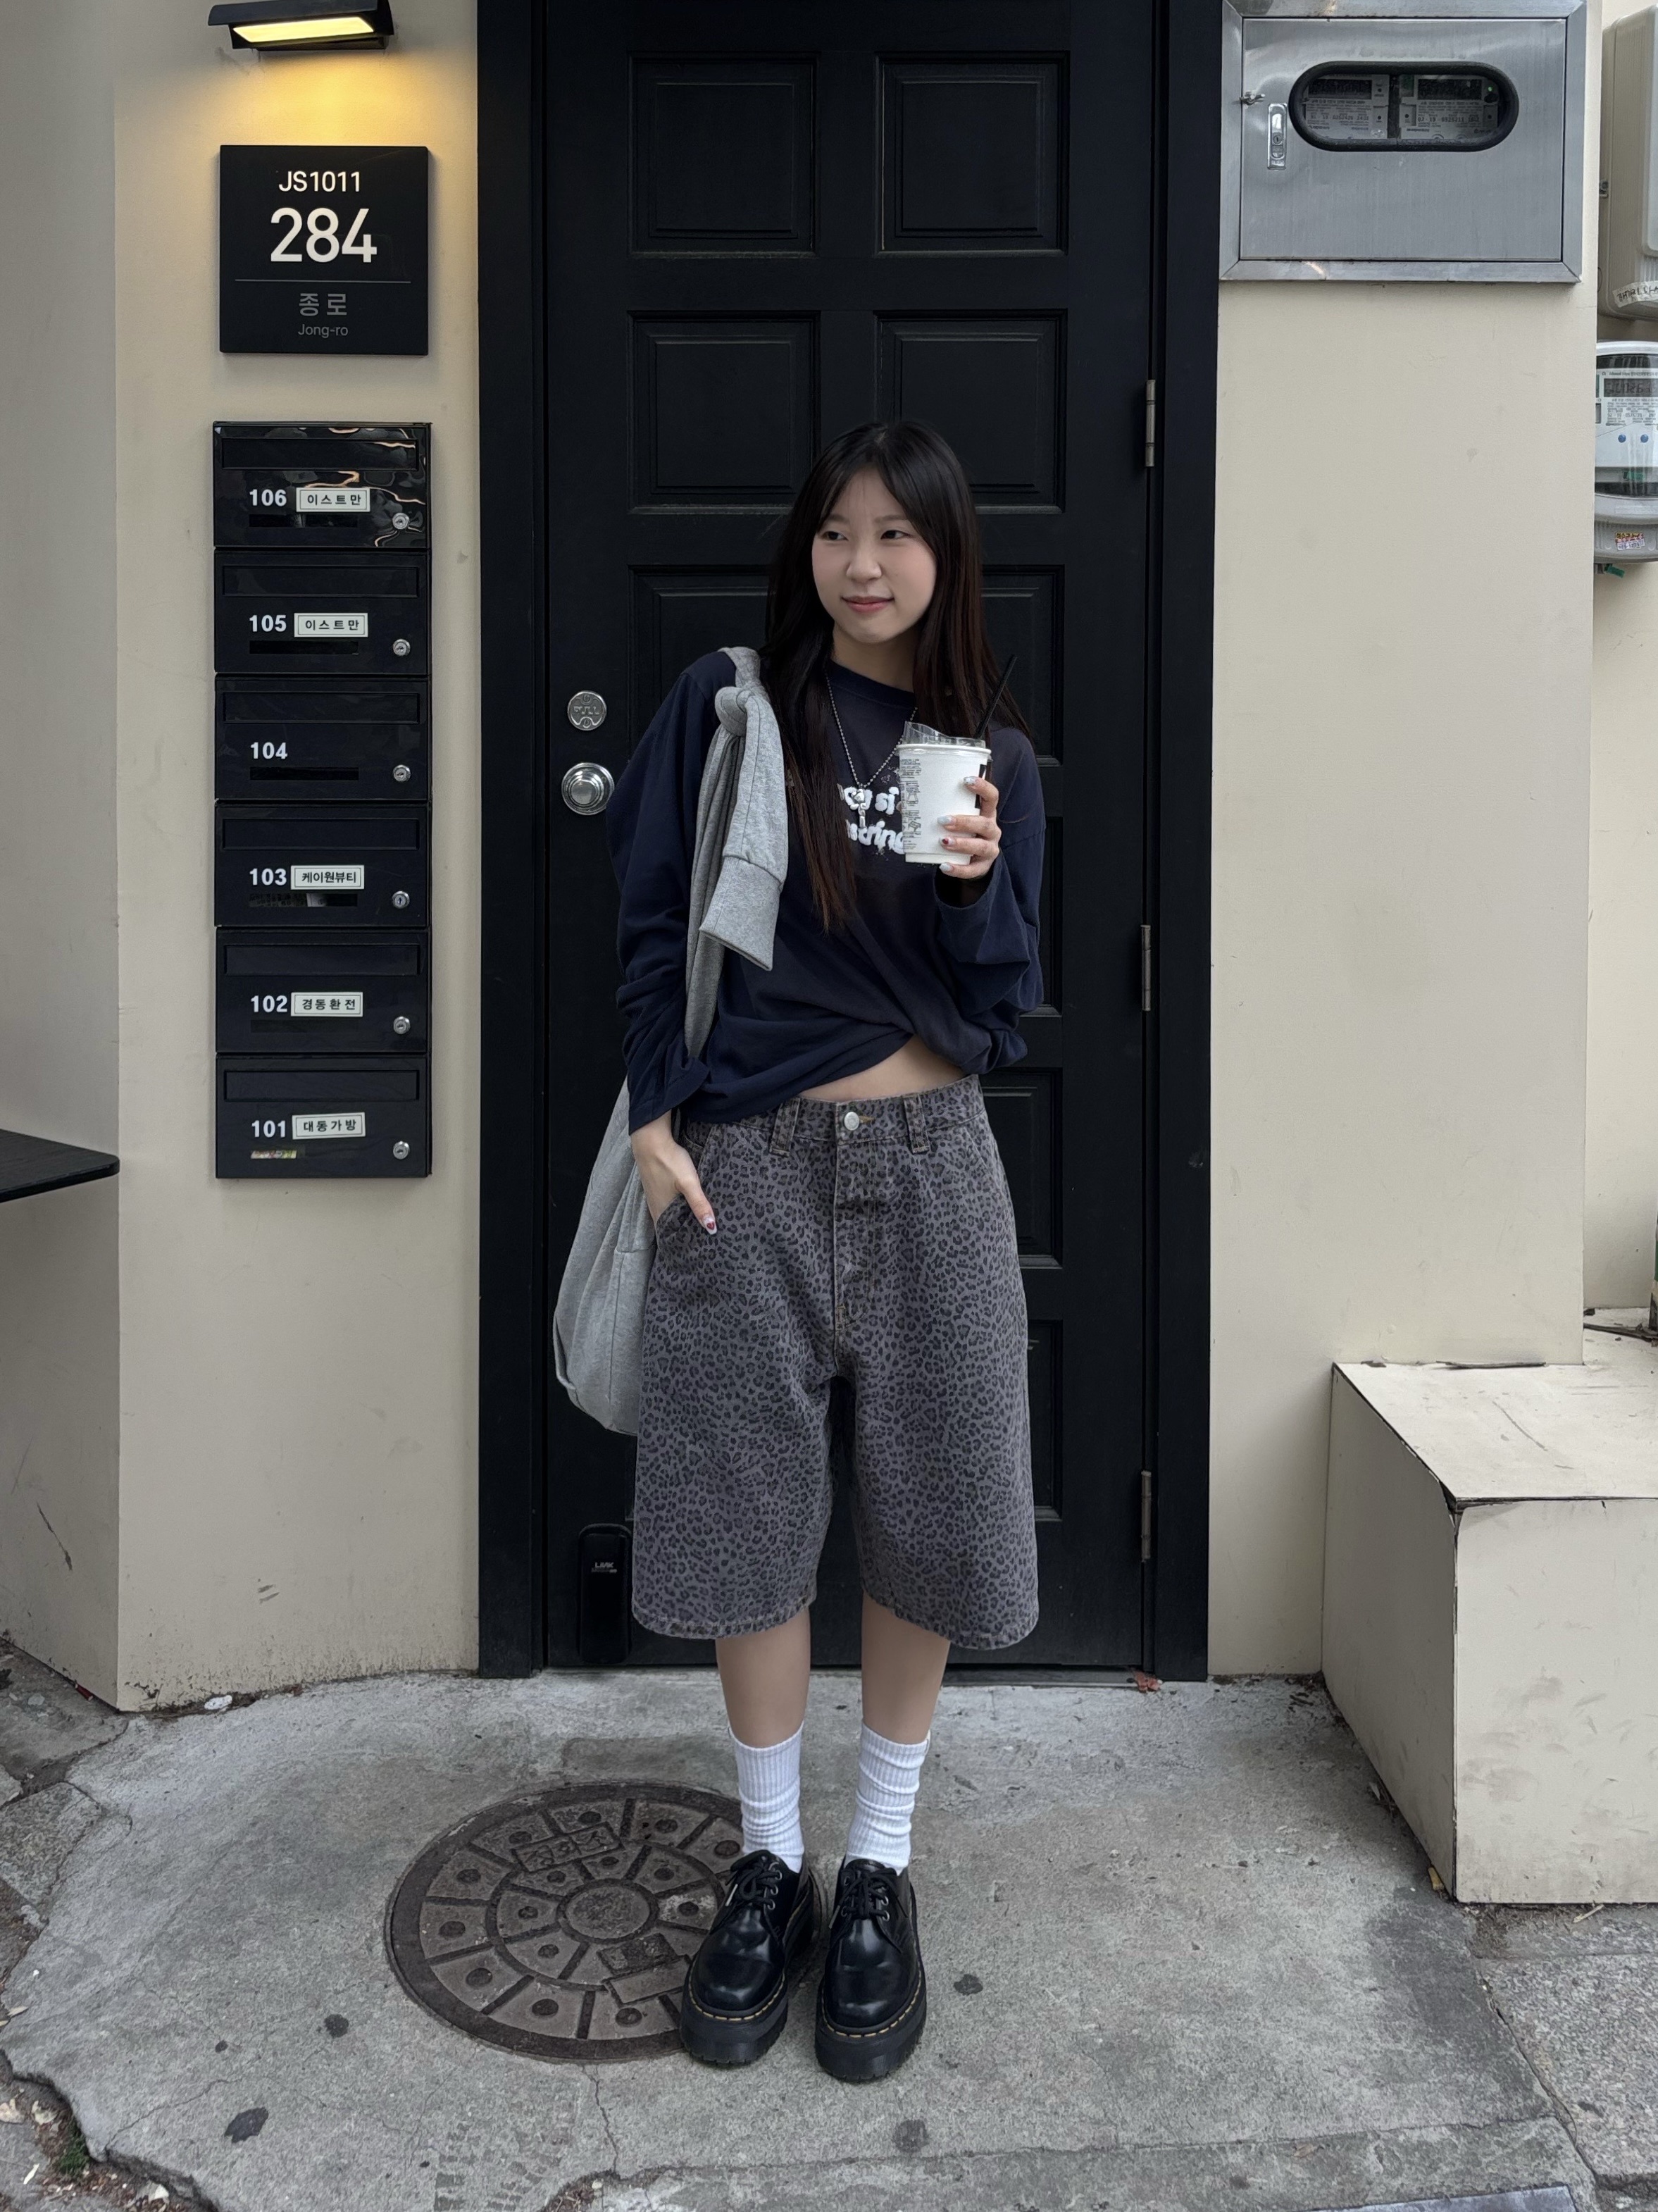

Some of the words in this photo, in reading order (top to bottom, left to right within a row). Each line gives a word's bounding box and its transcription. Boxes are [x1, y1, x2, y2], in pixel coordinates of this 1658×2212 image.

[278, 170, 360, 192] JS1011
[270, 207, 378, 263] 284
[299, 293, 347, 316] 종로
[298, 323, 349, 338] Jong-ro
[249, 489, 287, 507] 106
[307, 495, 361, 505] 이스트만
[249, 614, 287, 632] 105
[305, 619, 359, 630] 이스트만
[250, 742, 287, 759] 104
[249, 868, 287, 886] 103
[301, 871, 356, 883] 케이원뷰티
[251, 995, 288, 1012] 102
[251, 1120, 286, 1138] 101
[304, 1119, 356, 1132] 대동가방
